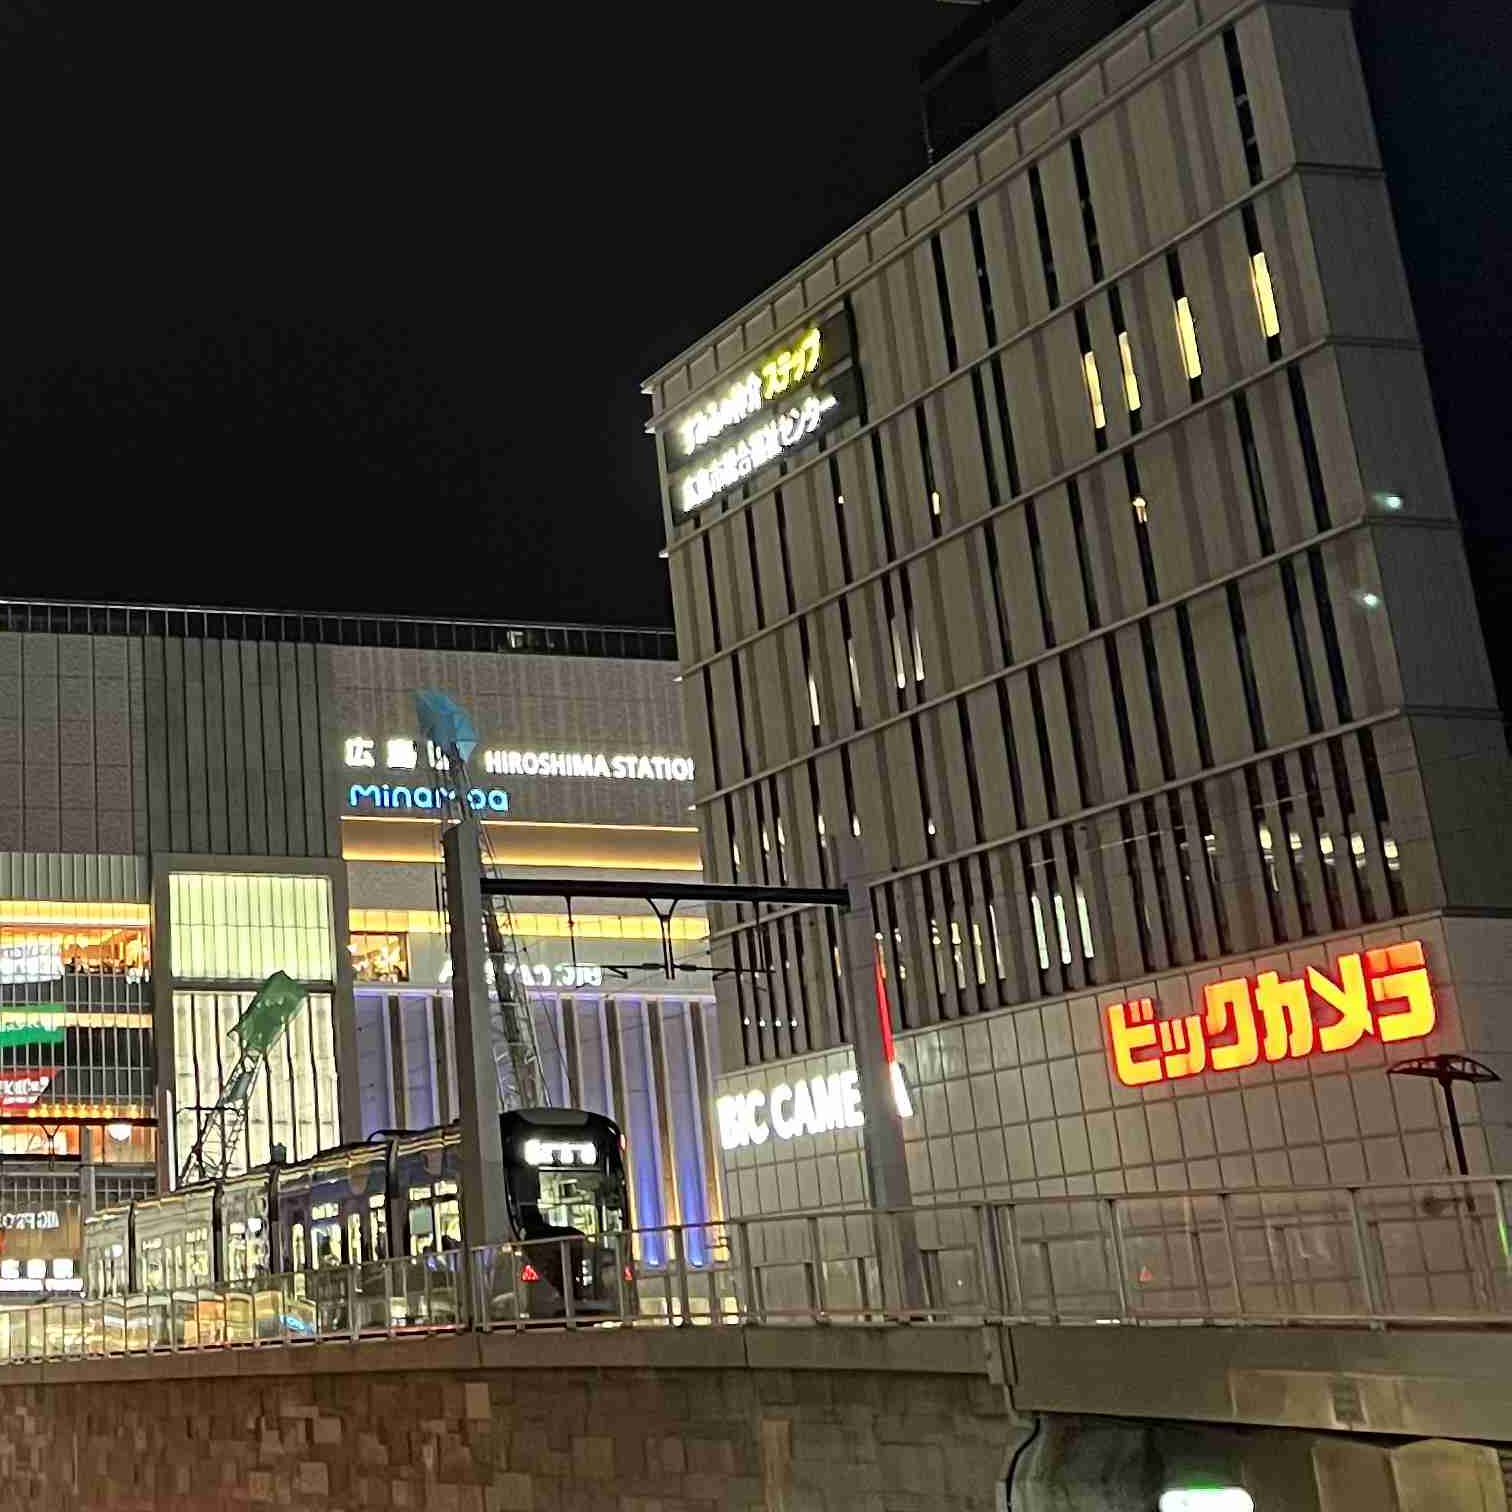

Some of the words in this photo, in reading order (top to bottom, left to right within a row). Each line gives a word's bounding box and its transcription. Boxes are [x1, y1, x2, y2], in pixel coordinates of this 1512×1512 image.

[485, 750, 610, 778] HIROSHIMA
[1107, 939, 1437, 1087] ビックカメラ
[716, 1089, 770, 1150] BIC
